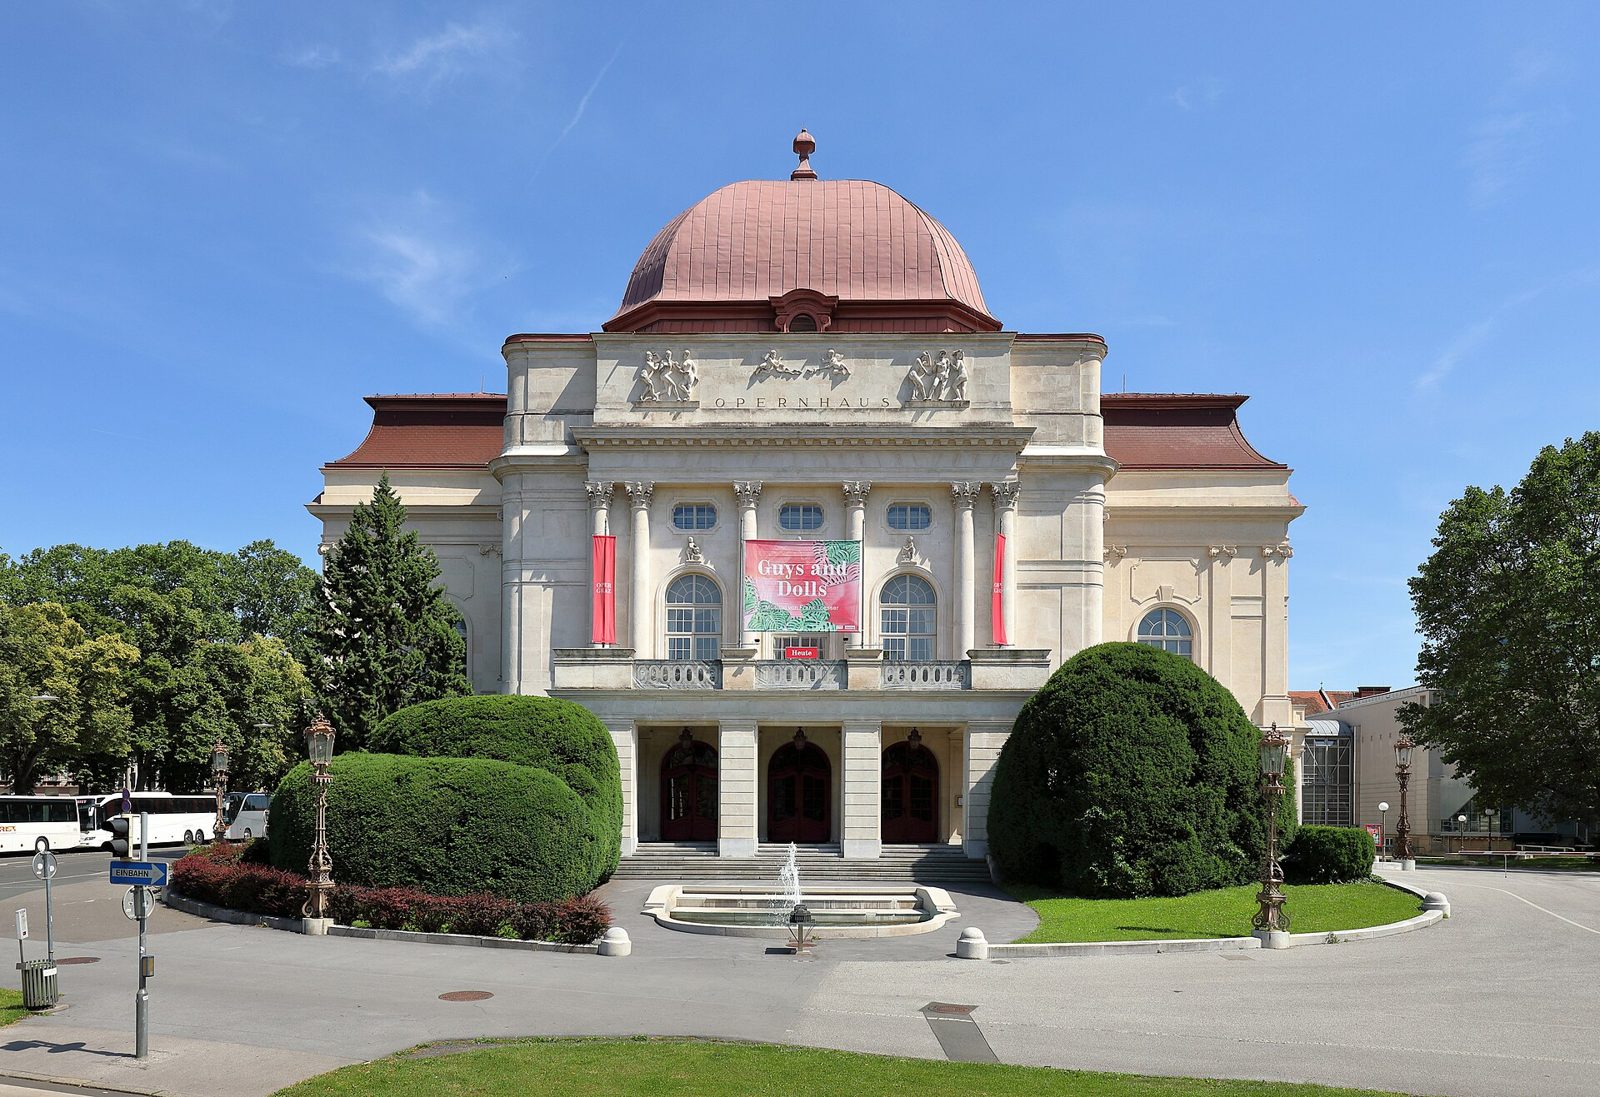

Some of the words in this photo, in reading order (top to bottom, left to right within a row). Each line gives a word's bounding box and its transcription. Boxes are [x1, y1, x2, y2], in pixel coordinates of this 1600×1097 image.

[715, 397, 890, 408] OPERNHAUS
[758, 560, 804, 579] Guys
[810, 560, 848, 576] and
[777, 580, 828, 598] Dolls
[791, 649, 813, 657] Heute
[115, 869, 149, 878] EINBAHN
